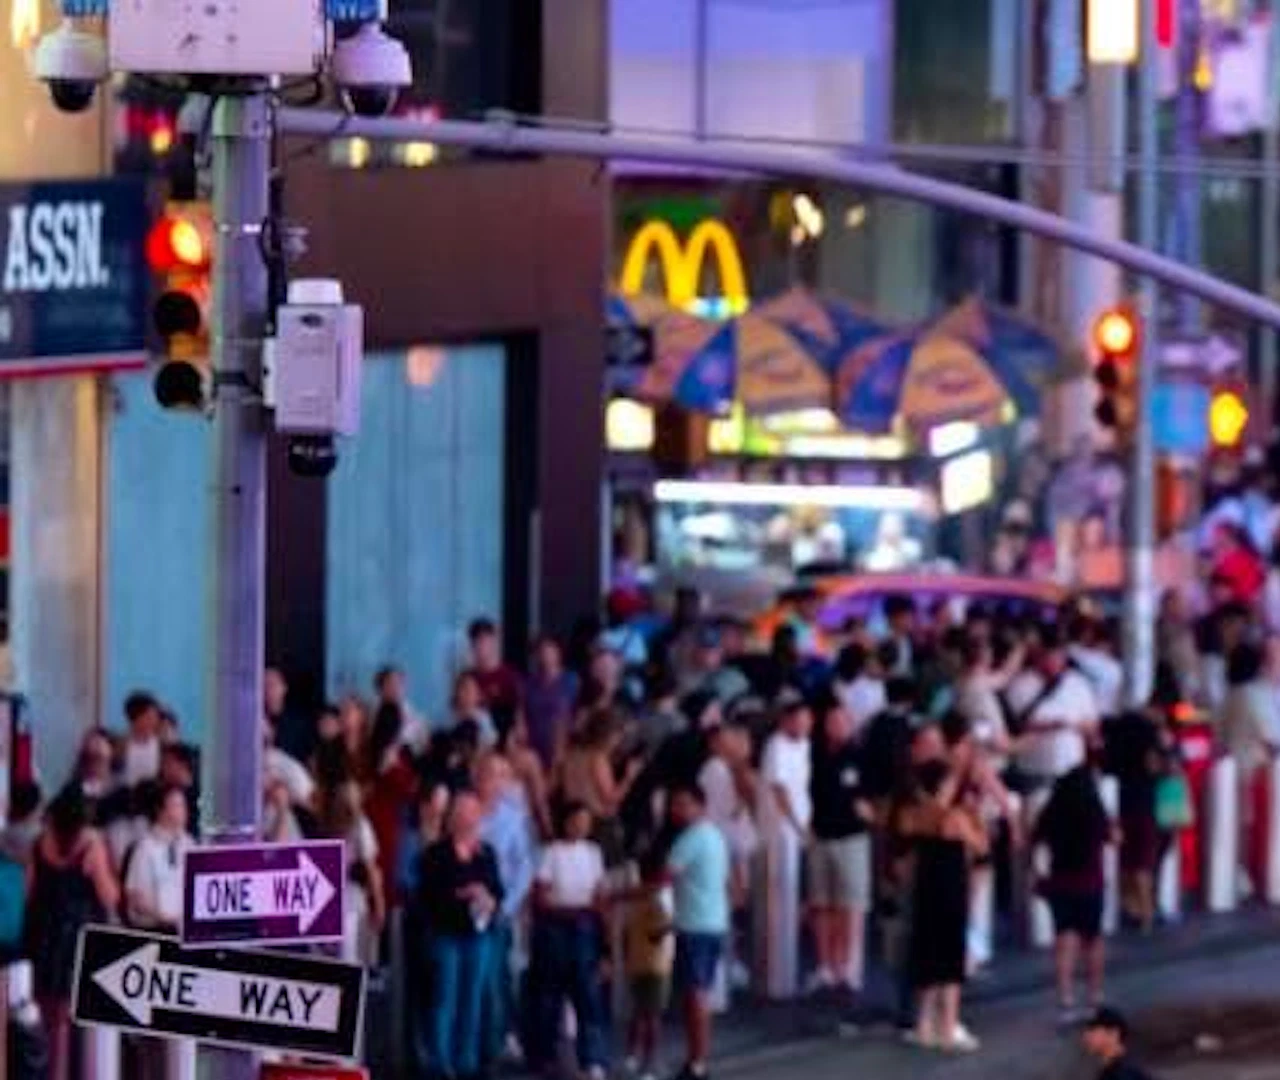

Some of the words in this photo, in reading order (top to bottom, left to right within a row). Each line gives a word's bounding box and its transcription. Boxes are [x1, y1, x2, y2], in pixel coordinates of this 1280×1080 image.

[4, 202, 110, 292] ASSN.
[205, 878, 253, 914] ONE
[272, 873, 319, 910] WAY
[121, 962, 199, 1007] ONE
[240, 979, 323, 1025] WAY
